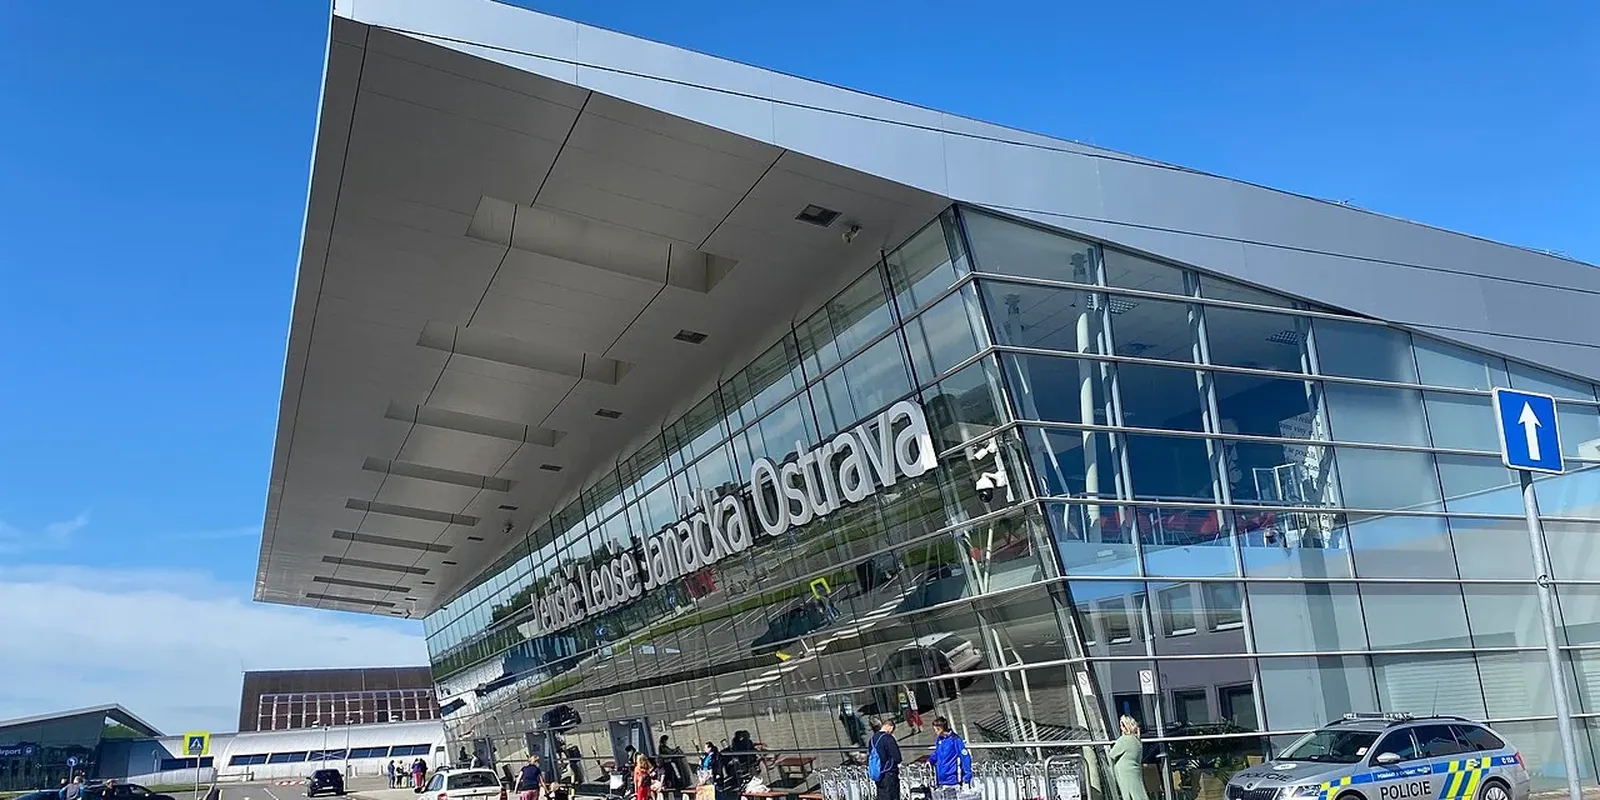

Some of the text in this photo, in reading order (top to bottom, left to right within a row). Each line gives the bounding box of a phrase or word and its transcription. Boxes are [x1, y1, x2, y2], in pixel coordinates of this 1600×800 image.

[578, 537, 642, 616] Leoše
[641, 487, 753, 590] Janáčka
[751, 400, 938, 537] Ostrava
[1380, 781, 1432, 800] POLICIE
